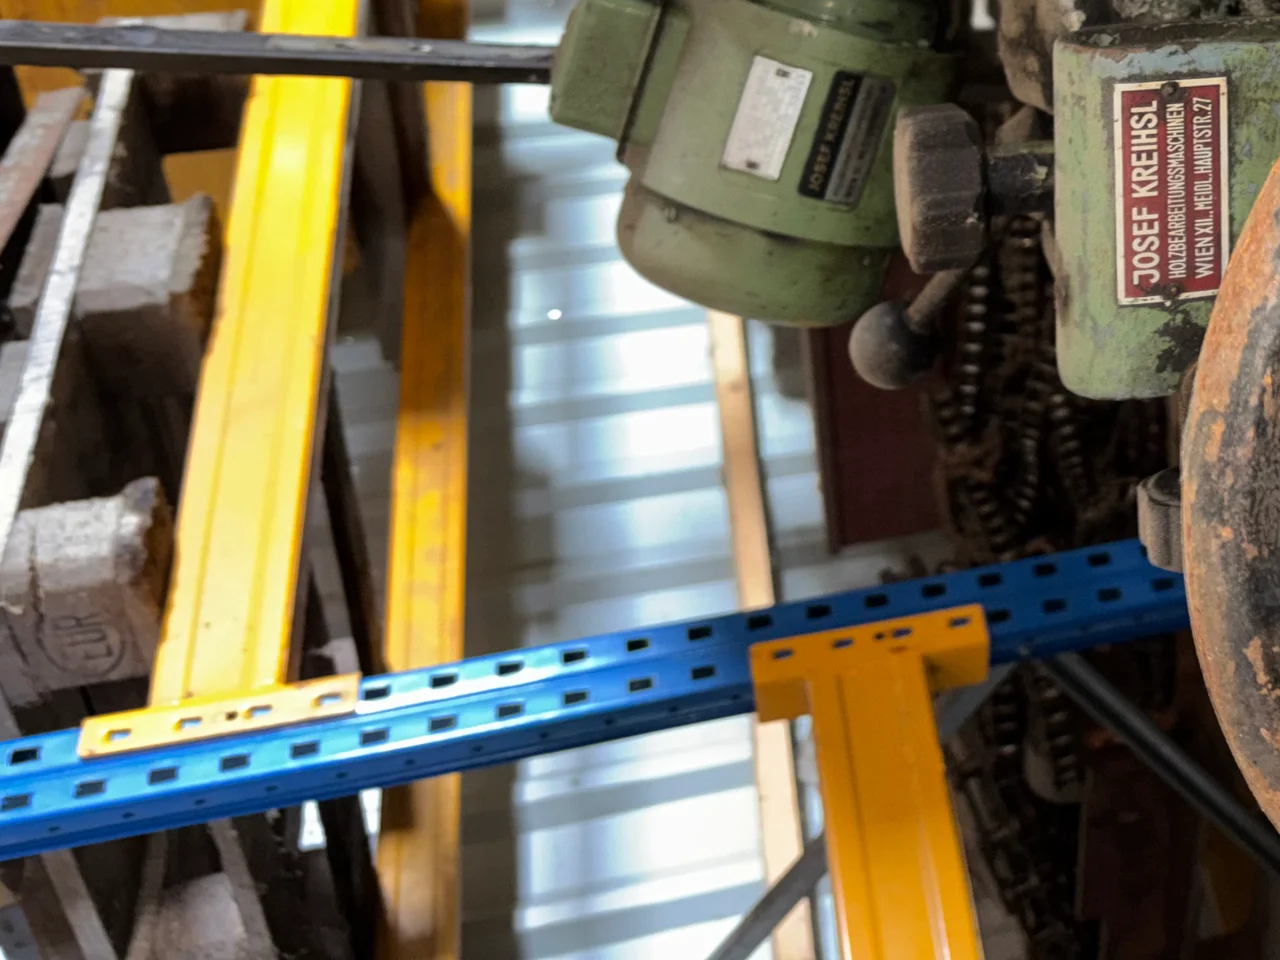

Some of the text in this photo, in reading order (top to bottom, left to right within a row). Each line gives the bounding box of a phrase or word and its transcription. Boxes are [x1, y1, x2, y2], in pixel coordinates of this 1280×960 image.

[1129, 100, 1160, 285] JOSEF KREIHSL
[1165, 102, 1187, 279] HOLZBEARBEITUNGSMASCHINEN
[1193, 236, 1215, 280] WIEN
[49, 611, 113, 663] EUR
